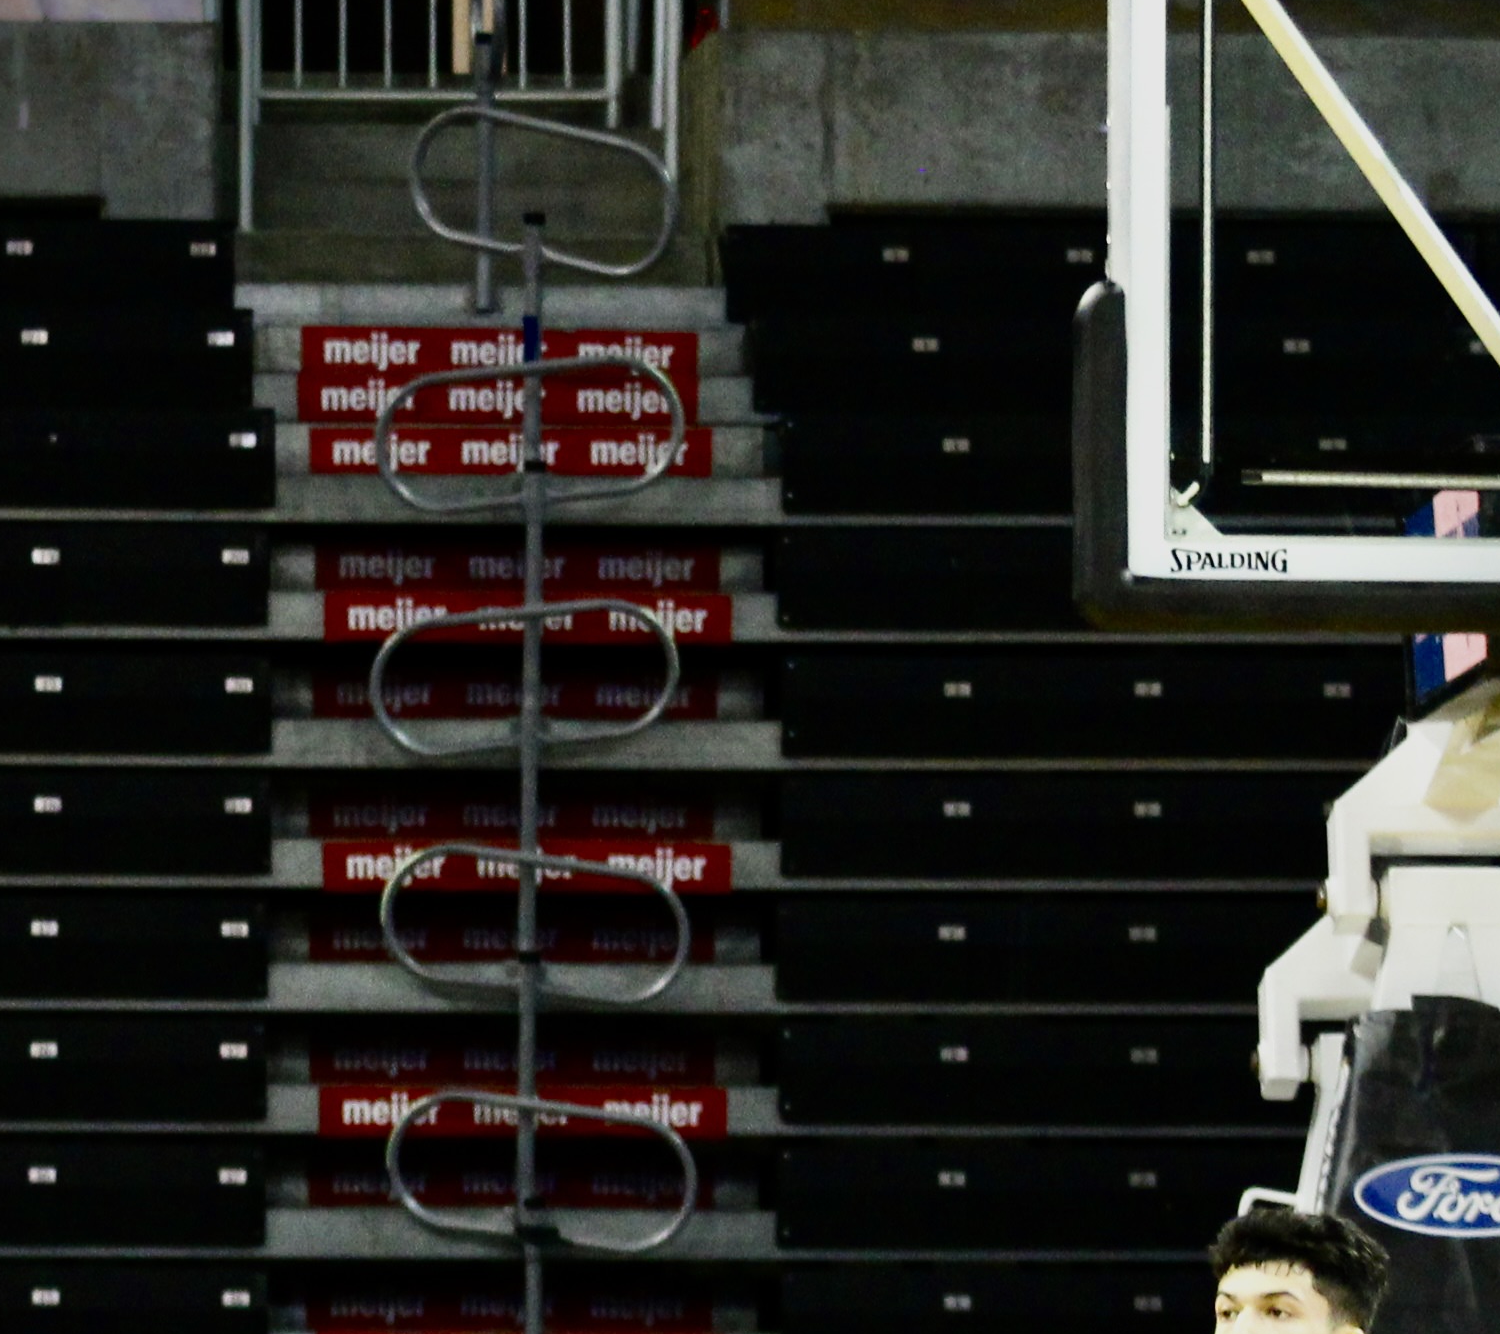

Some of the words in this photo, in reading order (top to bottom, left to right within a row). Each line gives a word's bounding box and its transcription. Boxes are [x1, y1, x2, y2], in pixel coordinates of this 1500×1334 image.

[323, 331, 421, 372] meijer
[332, 432, 431, 471] mejer
[1170, 548, 1288, 573] SPALDING
